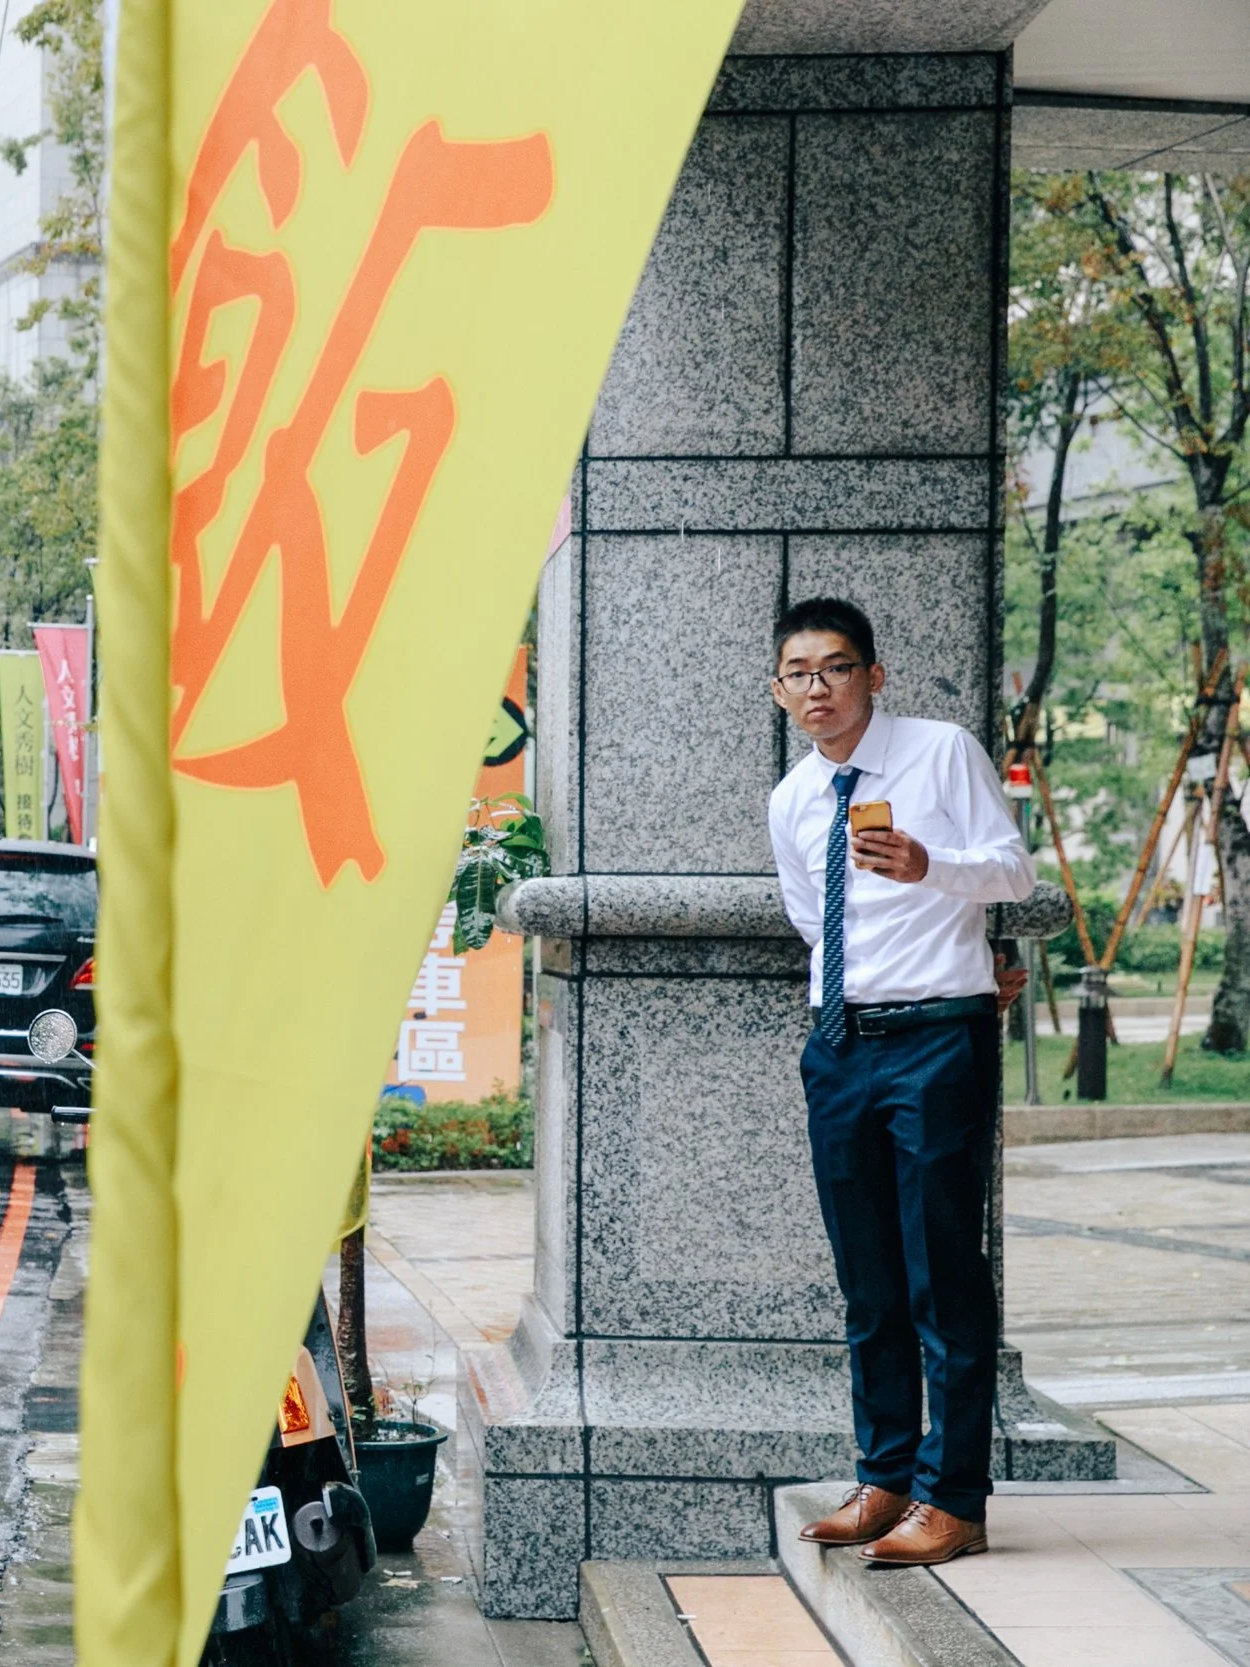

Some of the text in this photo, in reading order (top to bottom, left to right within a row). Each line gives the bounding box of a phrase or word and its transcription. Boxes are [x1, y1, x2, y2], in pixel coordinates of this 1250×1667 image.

[14, 684, 34, 776] 人文秀樹
[230, 1512, 285, 1559] AK
